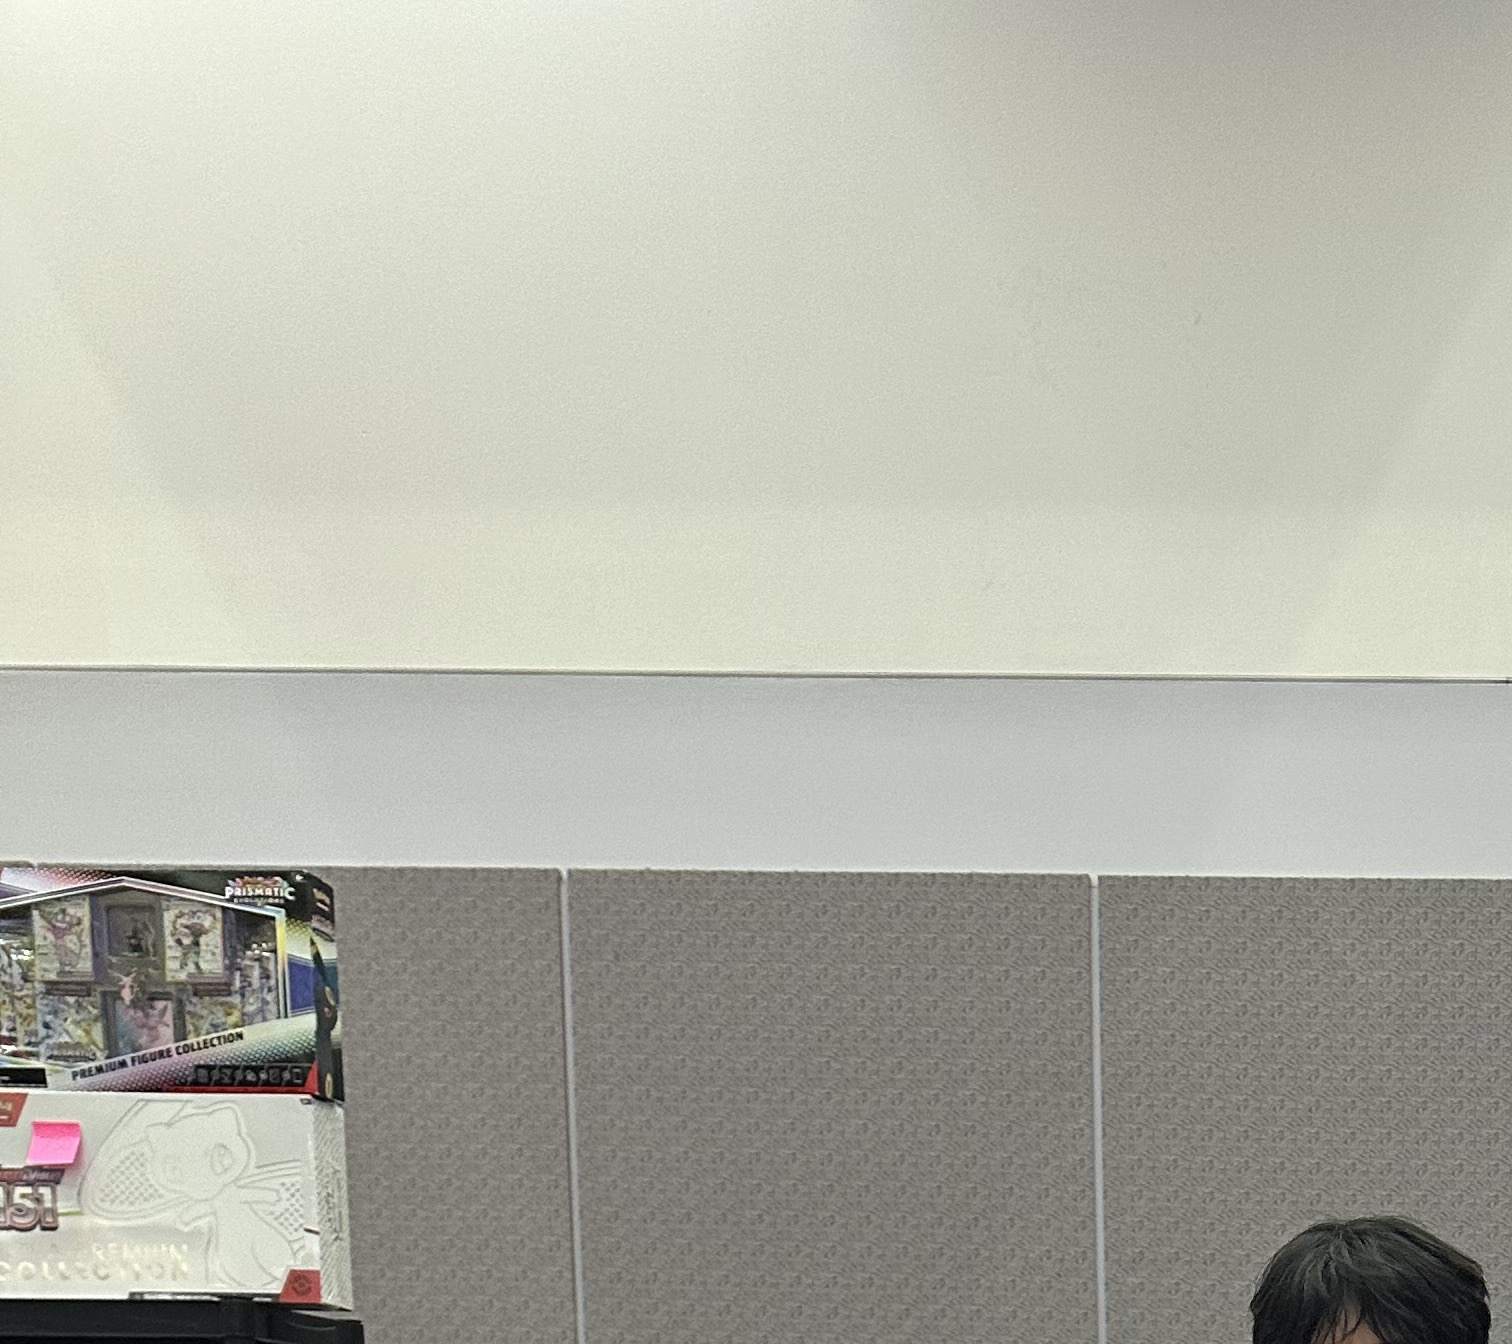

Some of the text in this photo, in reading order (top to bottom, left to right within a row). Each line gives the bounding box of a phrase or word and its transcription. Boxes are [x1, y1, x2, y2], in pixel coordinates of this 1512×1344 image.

[224, 886, 296, 901] PRISMATIC
[71, 1030, 245, 1081] PREMIUM FIGURE COLLECTION
